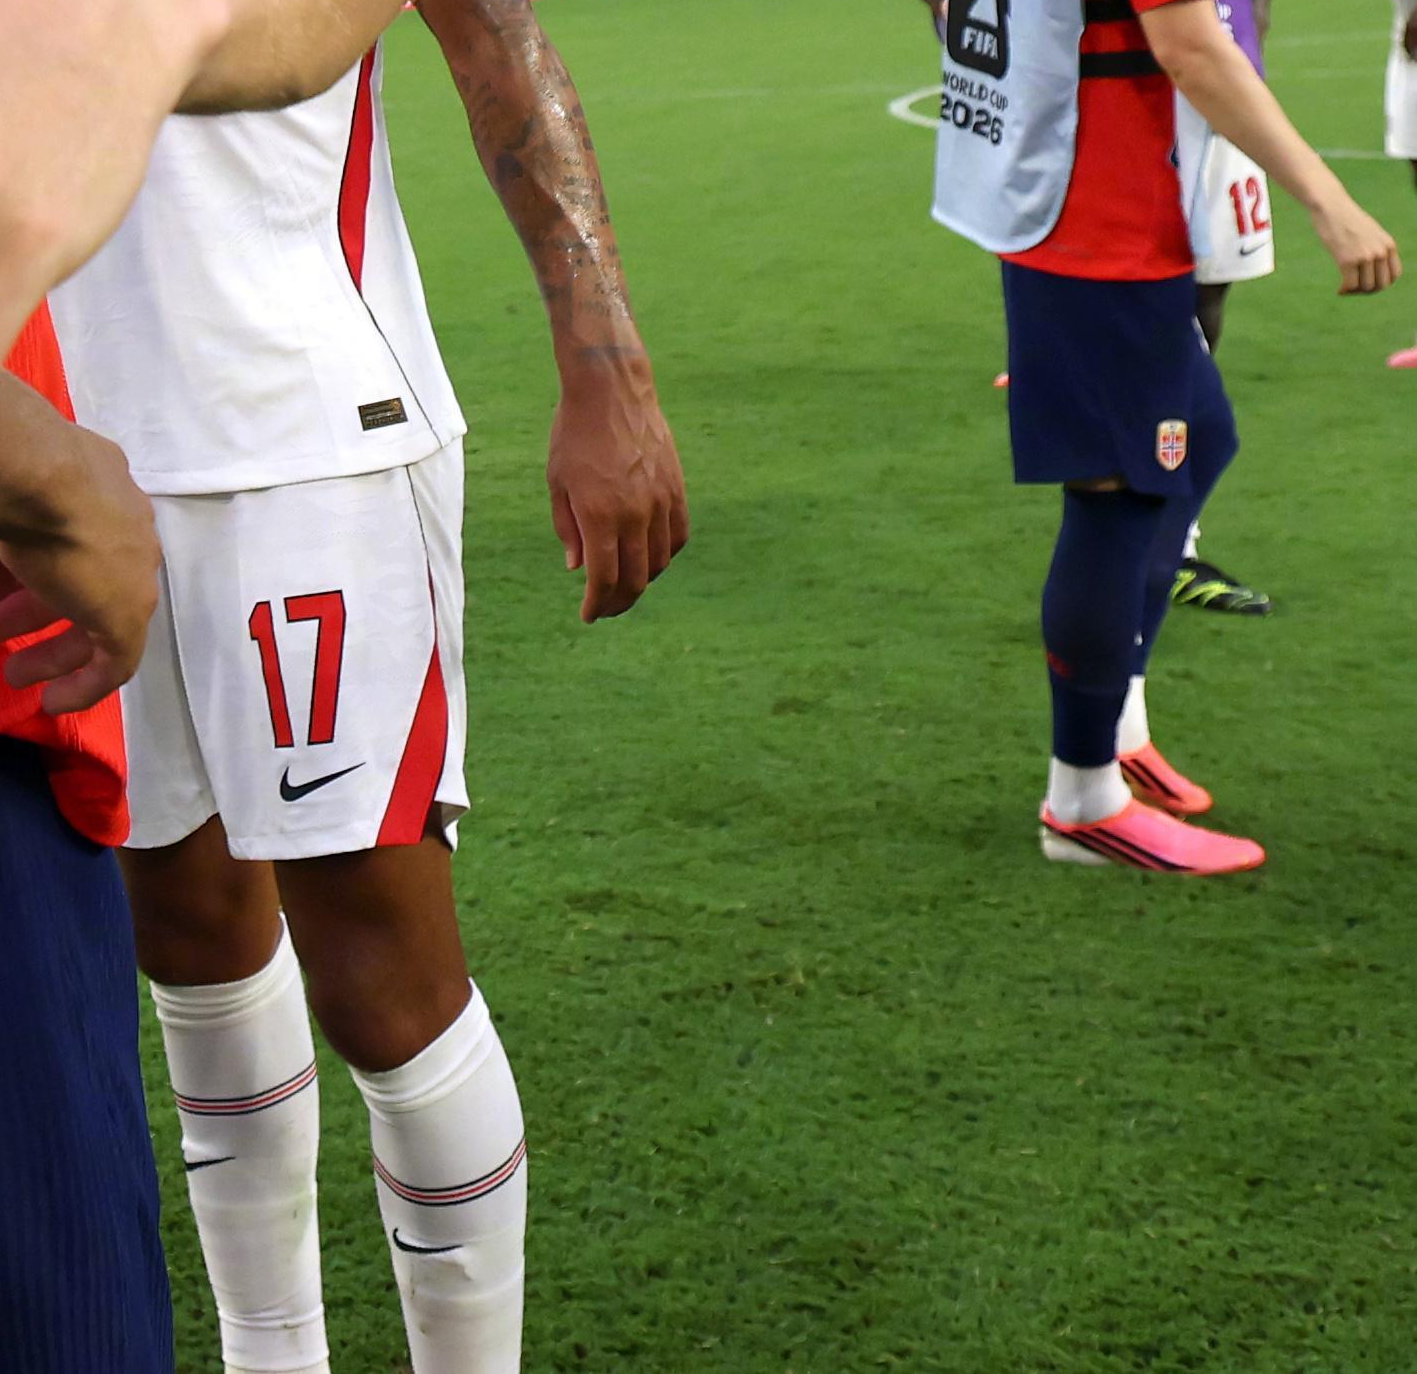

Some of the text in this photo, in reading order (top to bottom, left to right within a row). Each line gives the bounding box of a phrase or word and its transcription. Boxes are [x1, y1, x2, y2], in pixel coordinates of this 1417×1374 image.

[961, 26, 999, 60] FIFA
[943, 71, 1009, 112] WORLD CUP
[940, 92, 1004, 145] 2026
[1229, 176, 1271, 237] 12
[248, 589, 347, 749] 17
